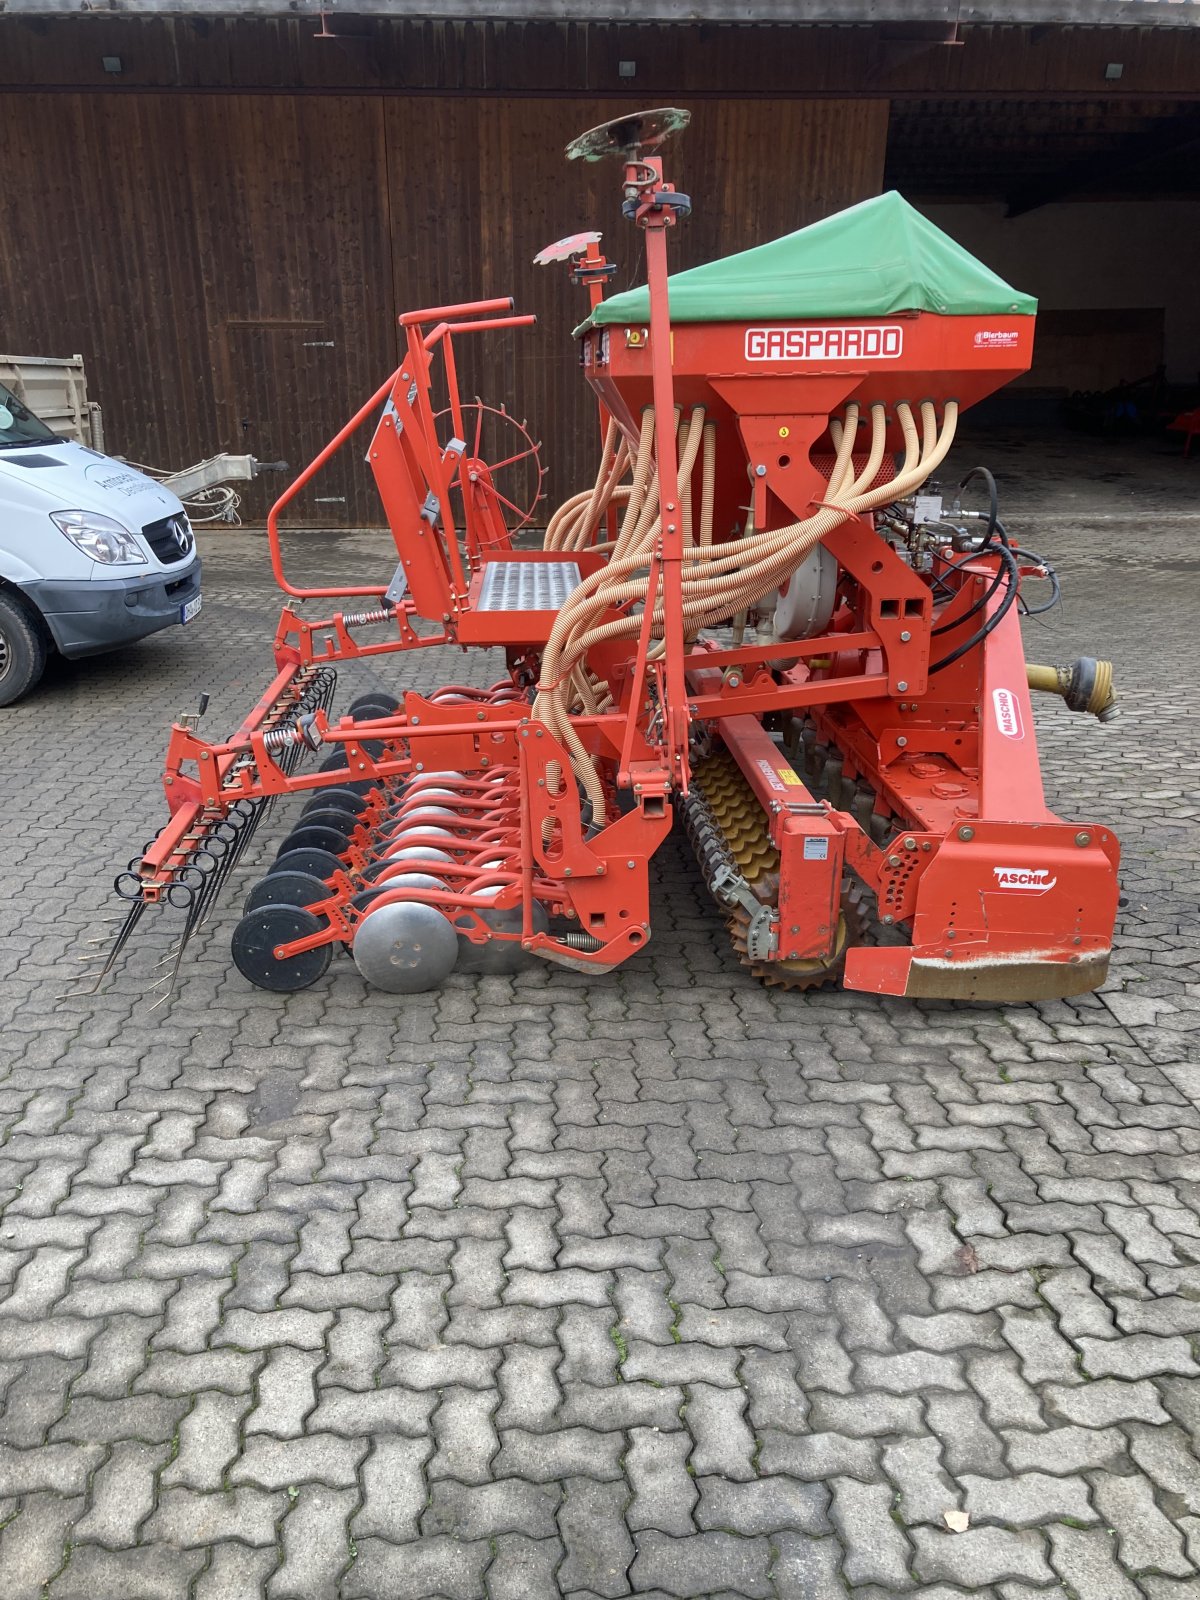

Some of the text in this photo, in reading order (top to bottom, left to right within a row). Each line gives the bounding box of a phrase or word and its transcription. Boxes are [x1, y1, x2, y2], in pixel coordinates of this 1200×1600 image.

[747, 329, 901, 358] GASPARDO
[983, 331, 1019, 339] Bierbaum
[998, 691, 1014, 733] MASCHIO
